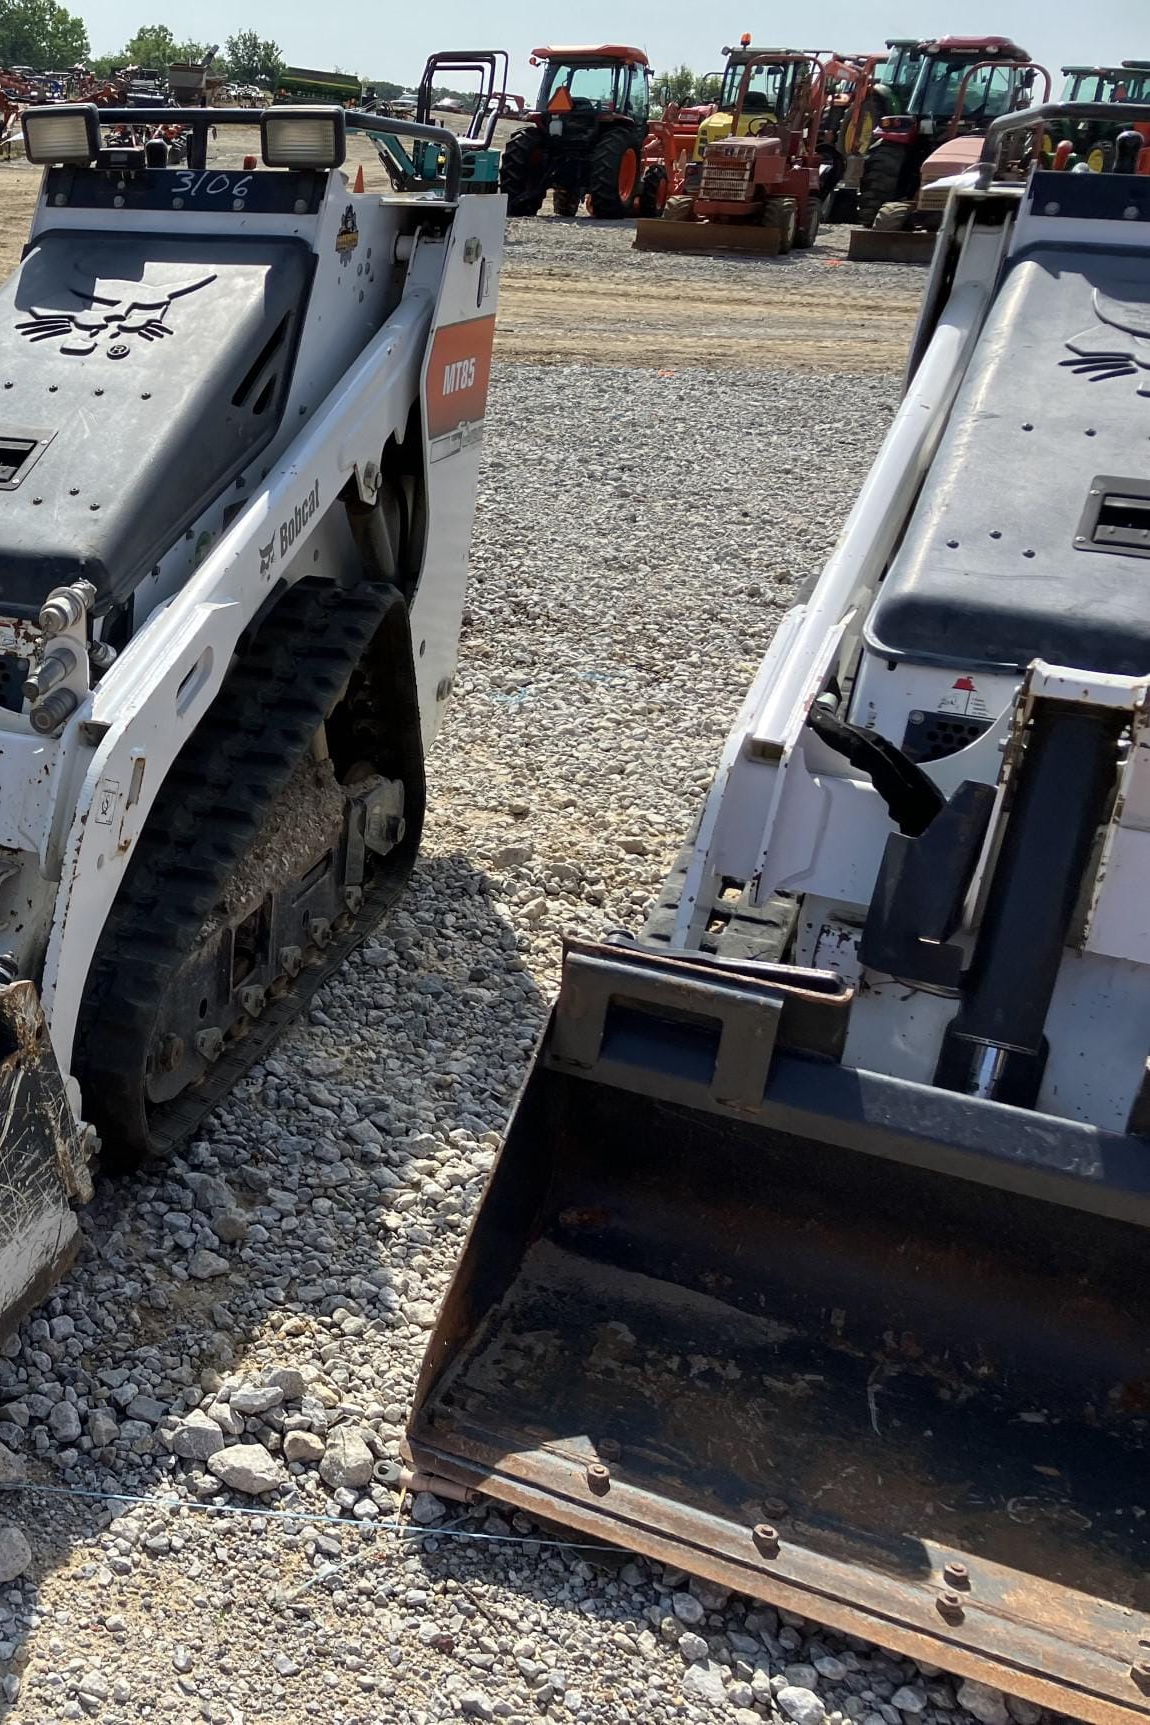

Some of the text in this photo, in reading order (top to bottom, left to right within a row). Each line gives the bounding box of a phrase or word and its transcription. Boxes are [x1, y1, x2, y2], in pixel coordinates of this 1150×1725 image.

[171, 170, 253, 197] 3106
[442, 357, 476, 396] MT85
[279, 478, 320, 558] Bobcat
